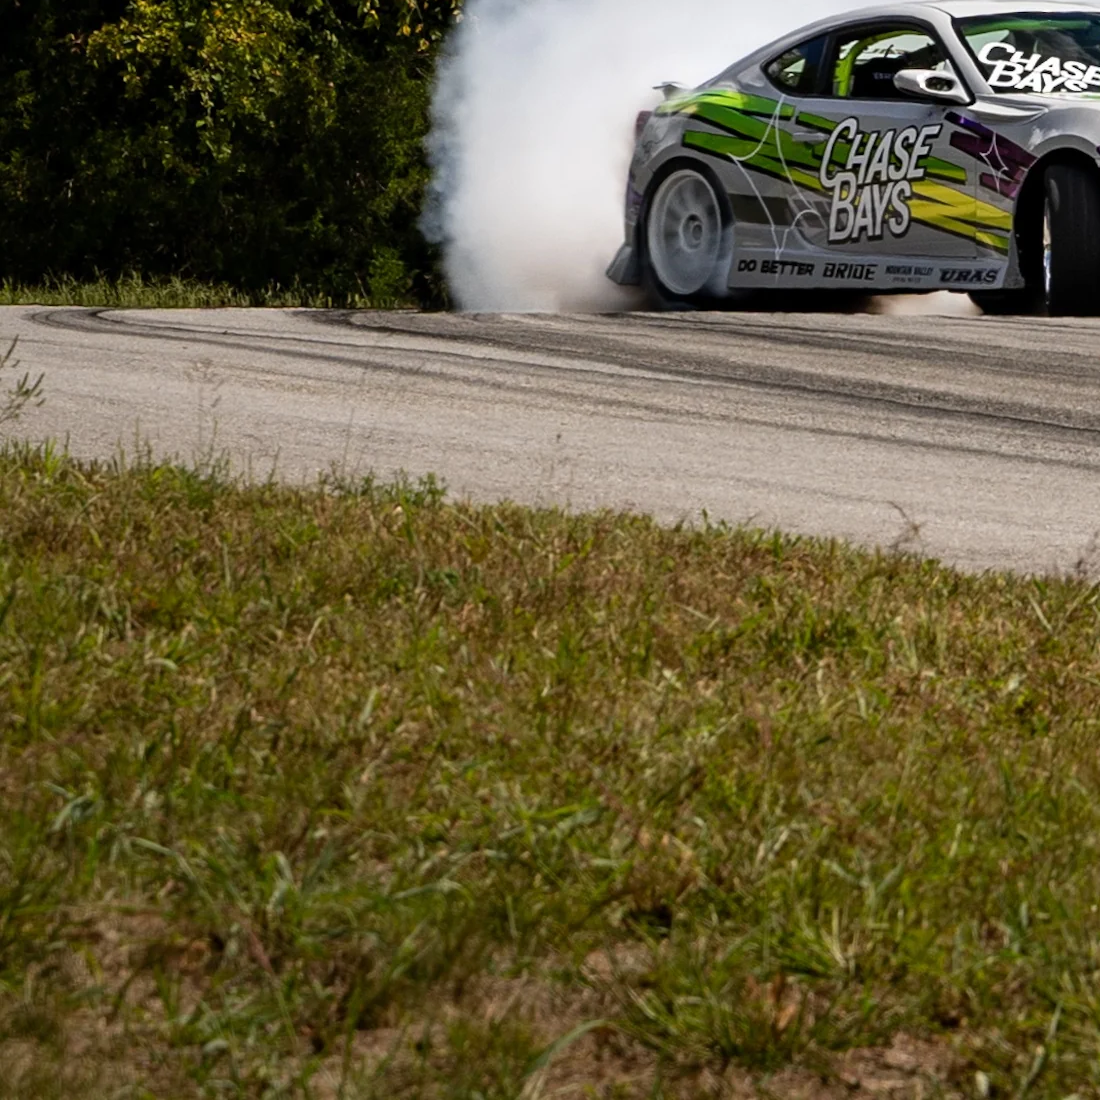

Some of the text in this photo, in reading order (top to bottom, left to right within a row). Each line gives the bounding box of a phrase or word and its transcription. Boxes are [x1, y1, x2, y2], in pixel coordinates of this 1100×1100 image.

[987, 60, 1088, 93] BAYS
[820, 117, 942, 187] CHASE
[828, 171, 911, 242] BAYS
[737, 260, 815, 276] DO BETTER
[822, 262, 878, 280] BRIDE
[940, 267, 1000, 285] URAS
